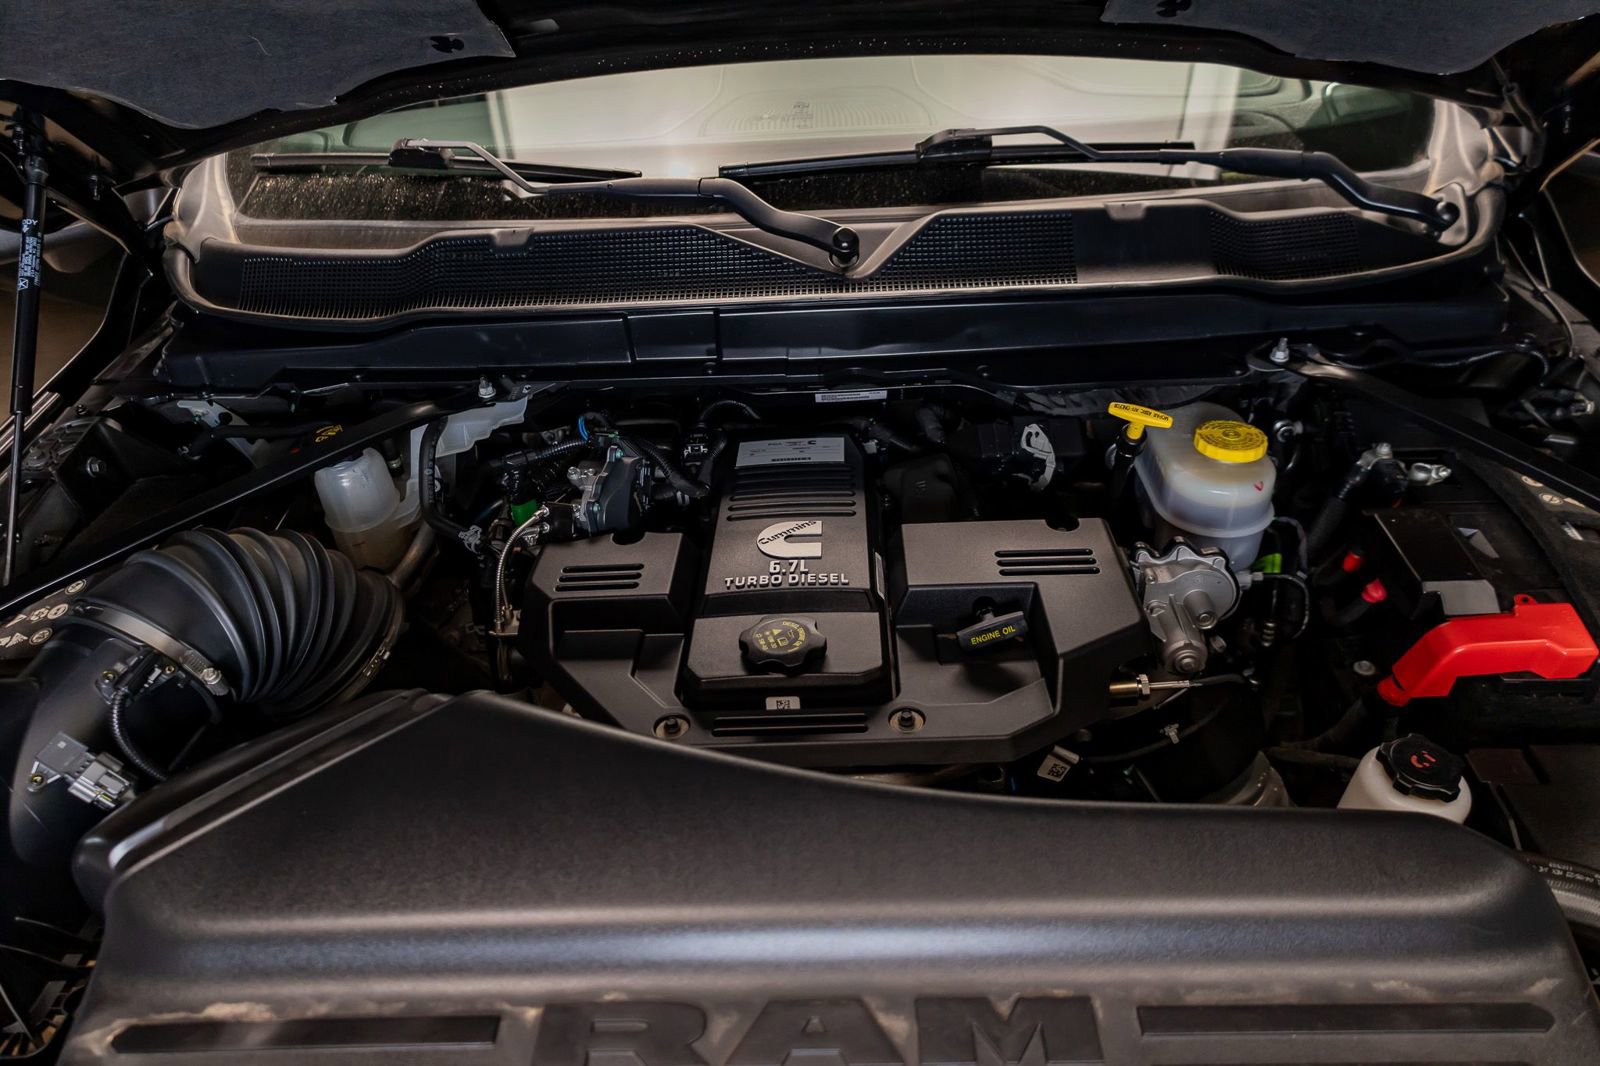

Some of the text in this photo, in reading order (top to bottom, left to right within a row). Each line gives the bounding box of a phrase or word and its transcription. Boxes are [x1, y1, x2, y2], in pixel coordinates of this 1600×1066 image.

[757, 520, 817, 545] Cummins
[769, 560, 809, 575] 6.7L
[725, 573, 849, 589] TURBO DIESEL
[970, 625, 1016, 645] ENGINE OIL
[530, 995, 1105, 1066] RAM
